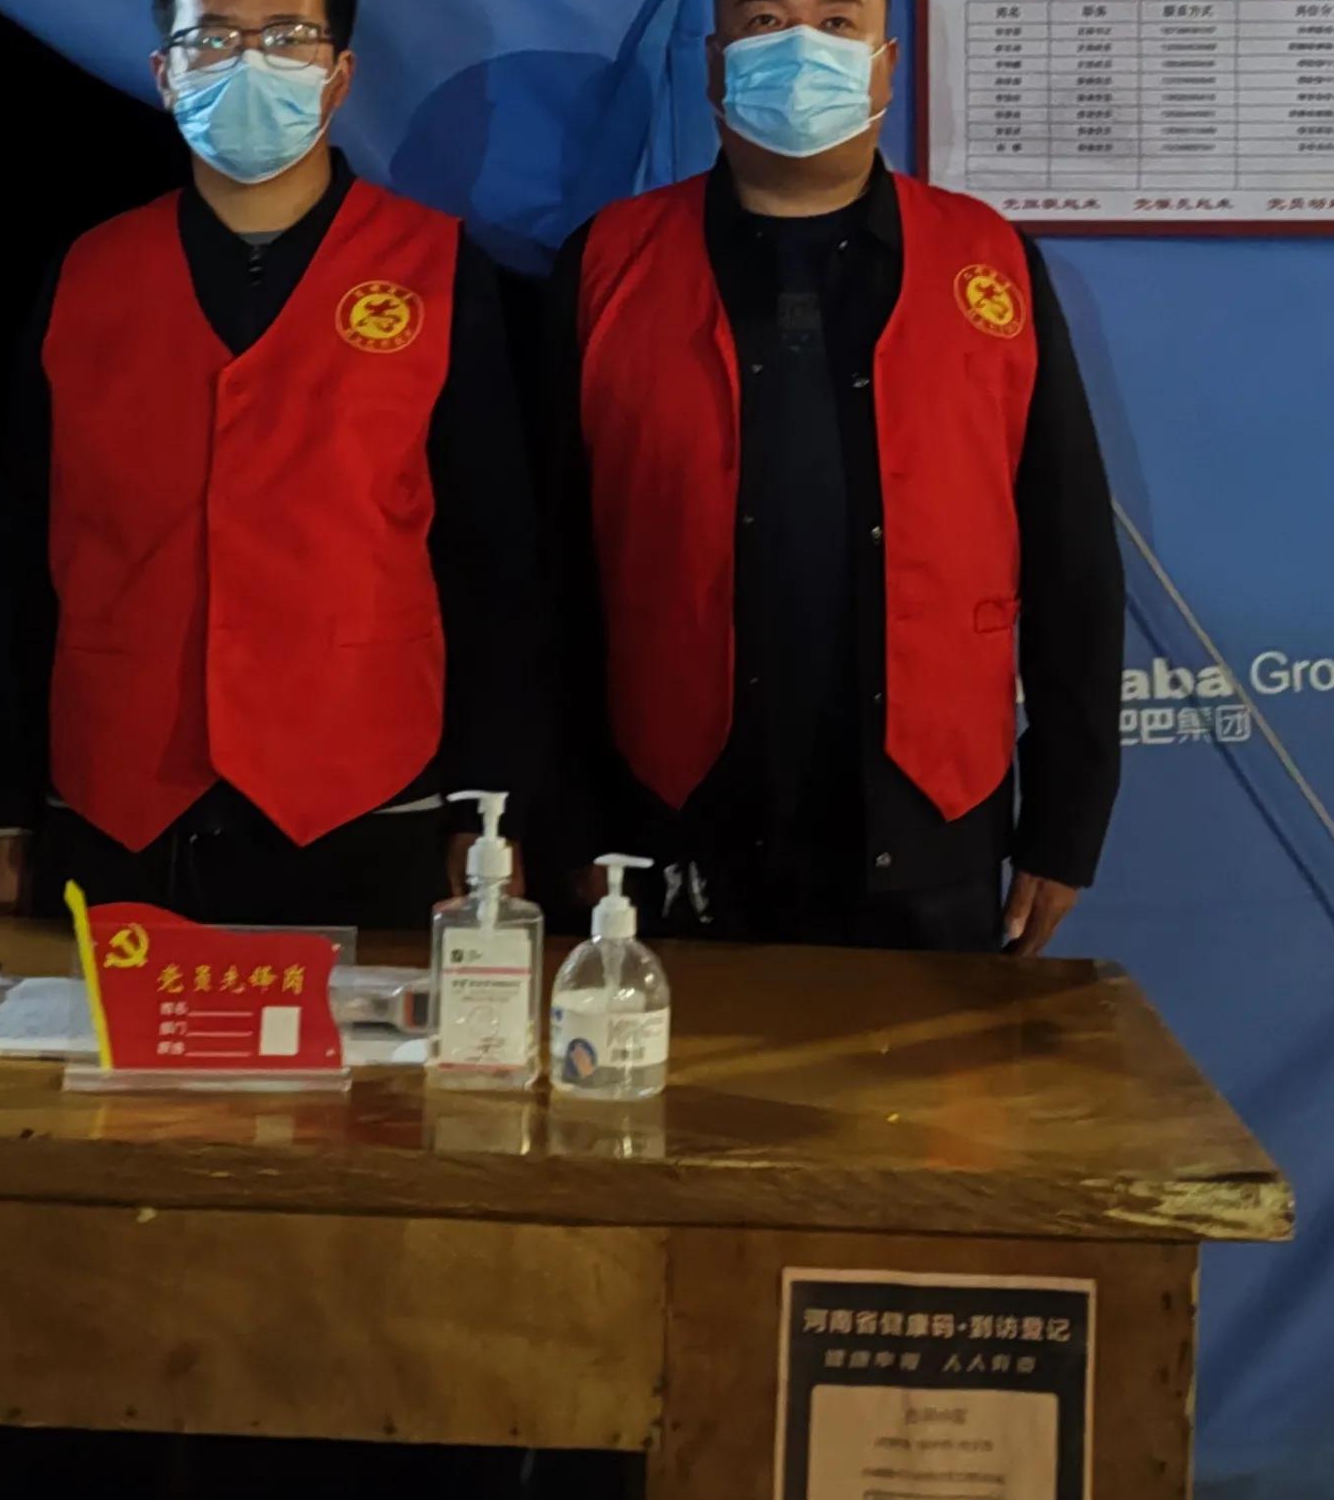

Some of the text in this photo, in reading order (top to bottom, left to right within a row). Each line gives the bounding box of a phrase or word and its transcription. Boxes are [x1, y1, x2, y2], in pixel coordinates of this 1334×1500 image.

[156, 963, 306, 995] 党员先锋岗
